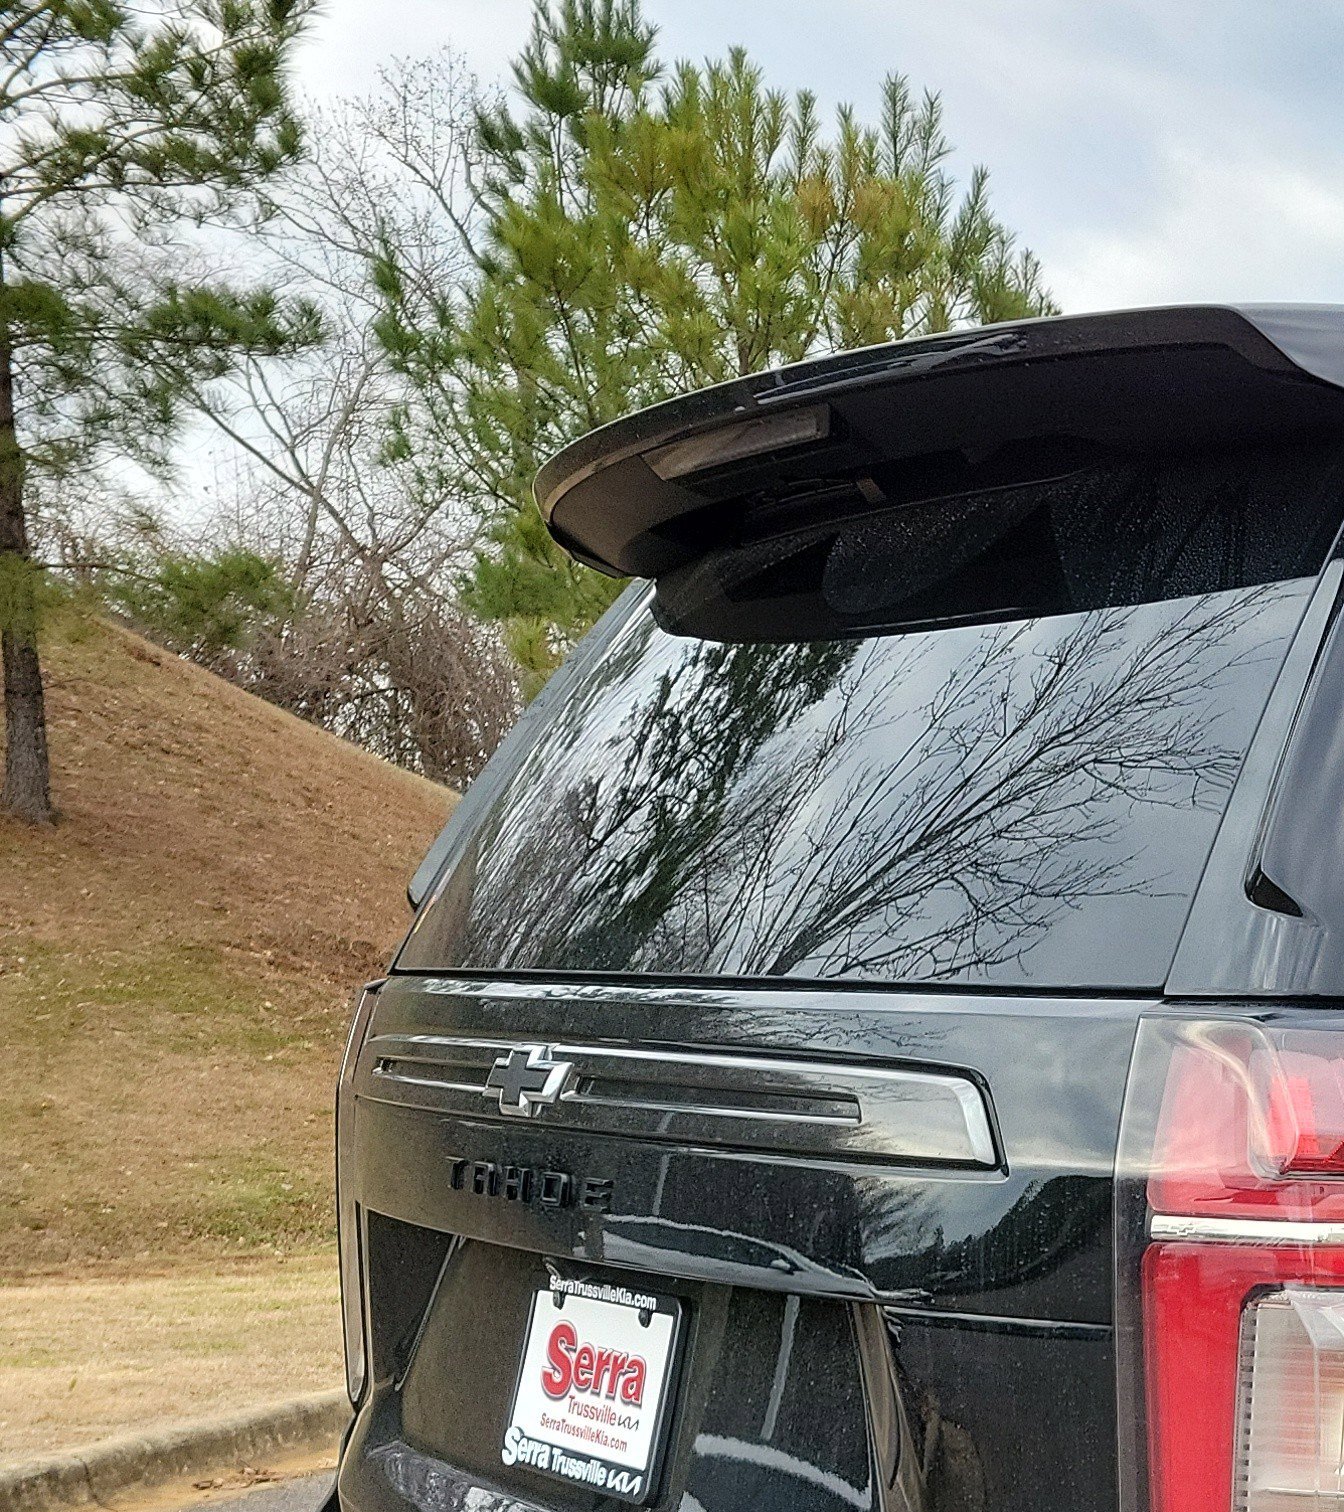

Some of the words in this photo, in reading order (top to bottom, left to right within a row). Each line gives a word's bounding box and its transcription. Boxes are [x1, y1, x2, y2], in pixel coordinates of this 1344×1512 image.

[445, 1156, 614, 1213] TAHOE
[550, 1274, 657, 1310] SerraTrussvilleKia.com
[540, 1319, 647, 1408] Serra
[540, 1412, 628, 1452] SerraTrussvilleKia.com
[567, 1395, 617, 1425] Trussville
[502, 1425, 550, 1469] Serra
[551, 1448, 607, 1486] Trussville
